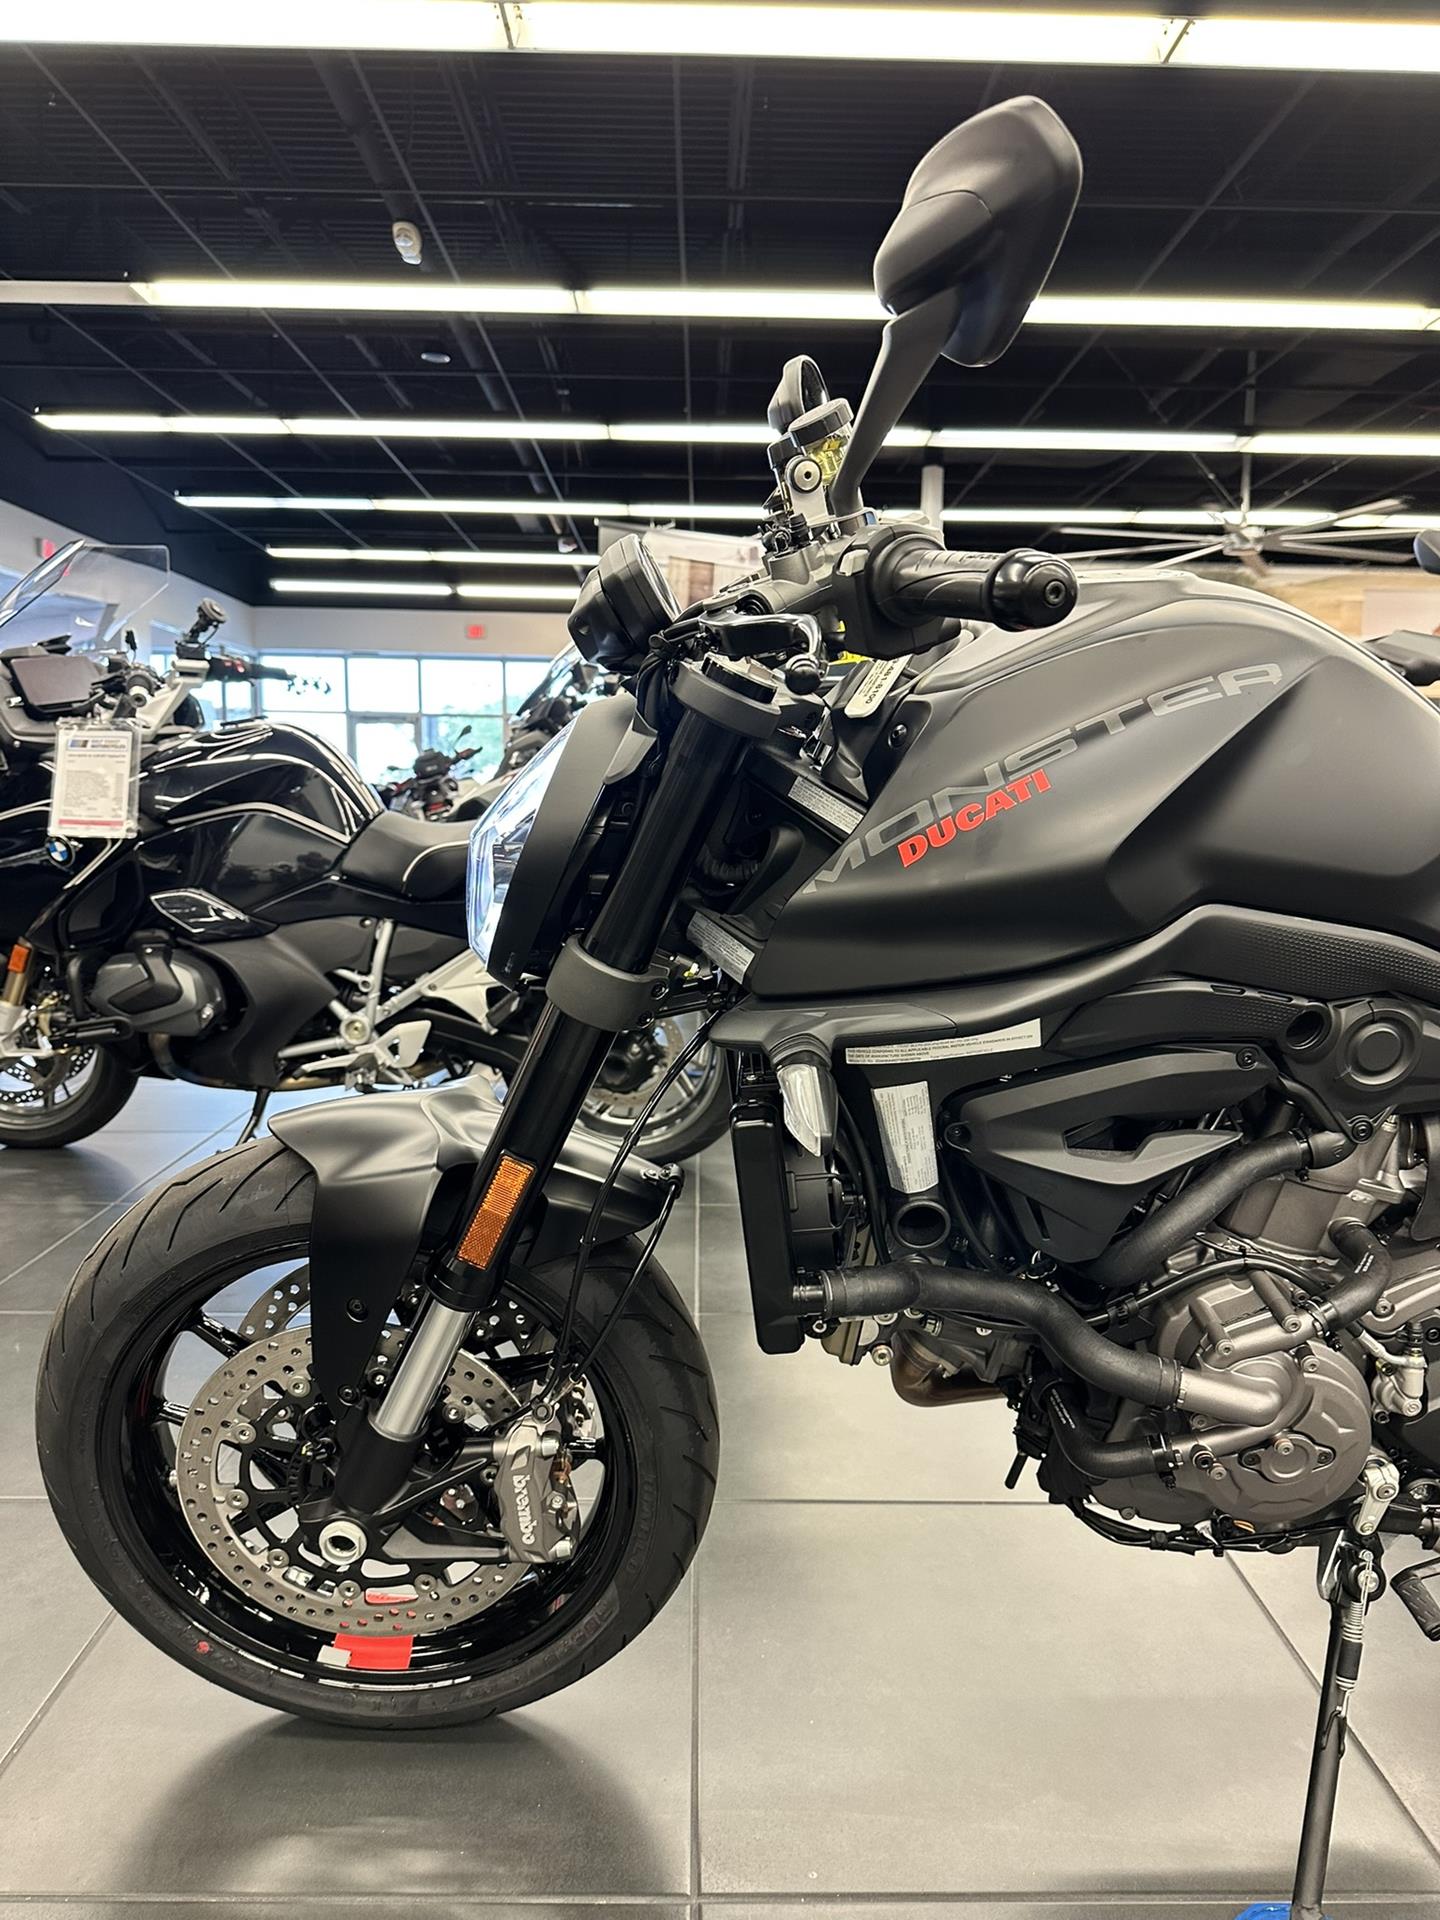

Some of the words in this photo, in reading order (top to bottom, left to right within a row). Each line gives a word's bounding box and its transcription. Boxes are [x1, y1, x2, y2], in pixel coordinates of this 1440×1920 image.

[802, 662, 1284, 895] MONSTER
[897, 769, 1052, 869] DUCATI
[512, 1474, 537, 1545] brembo
